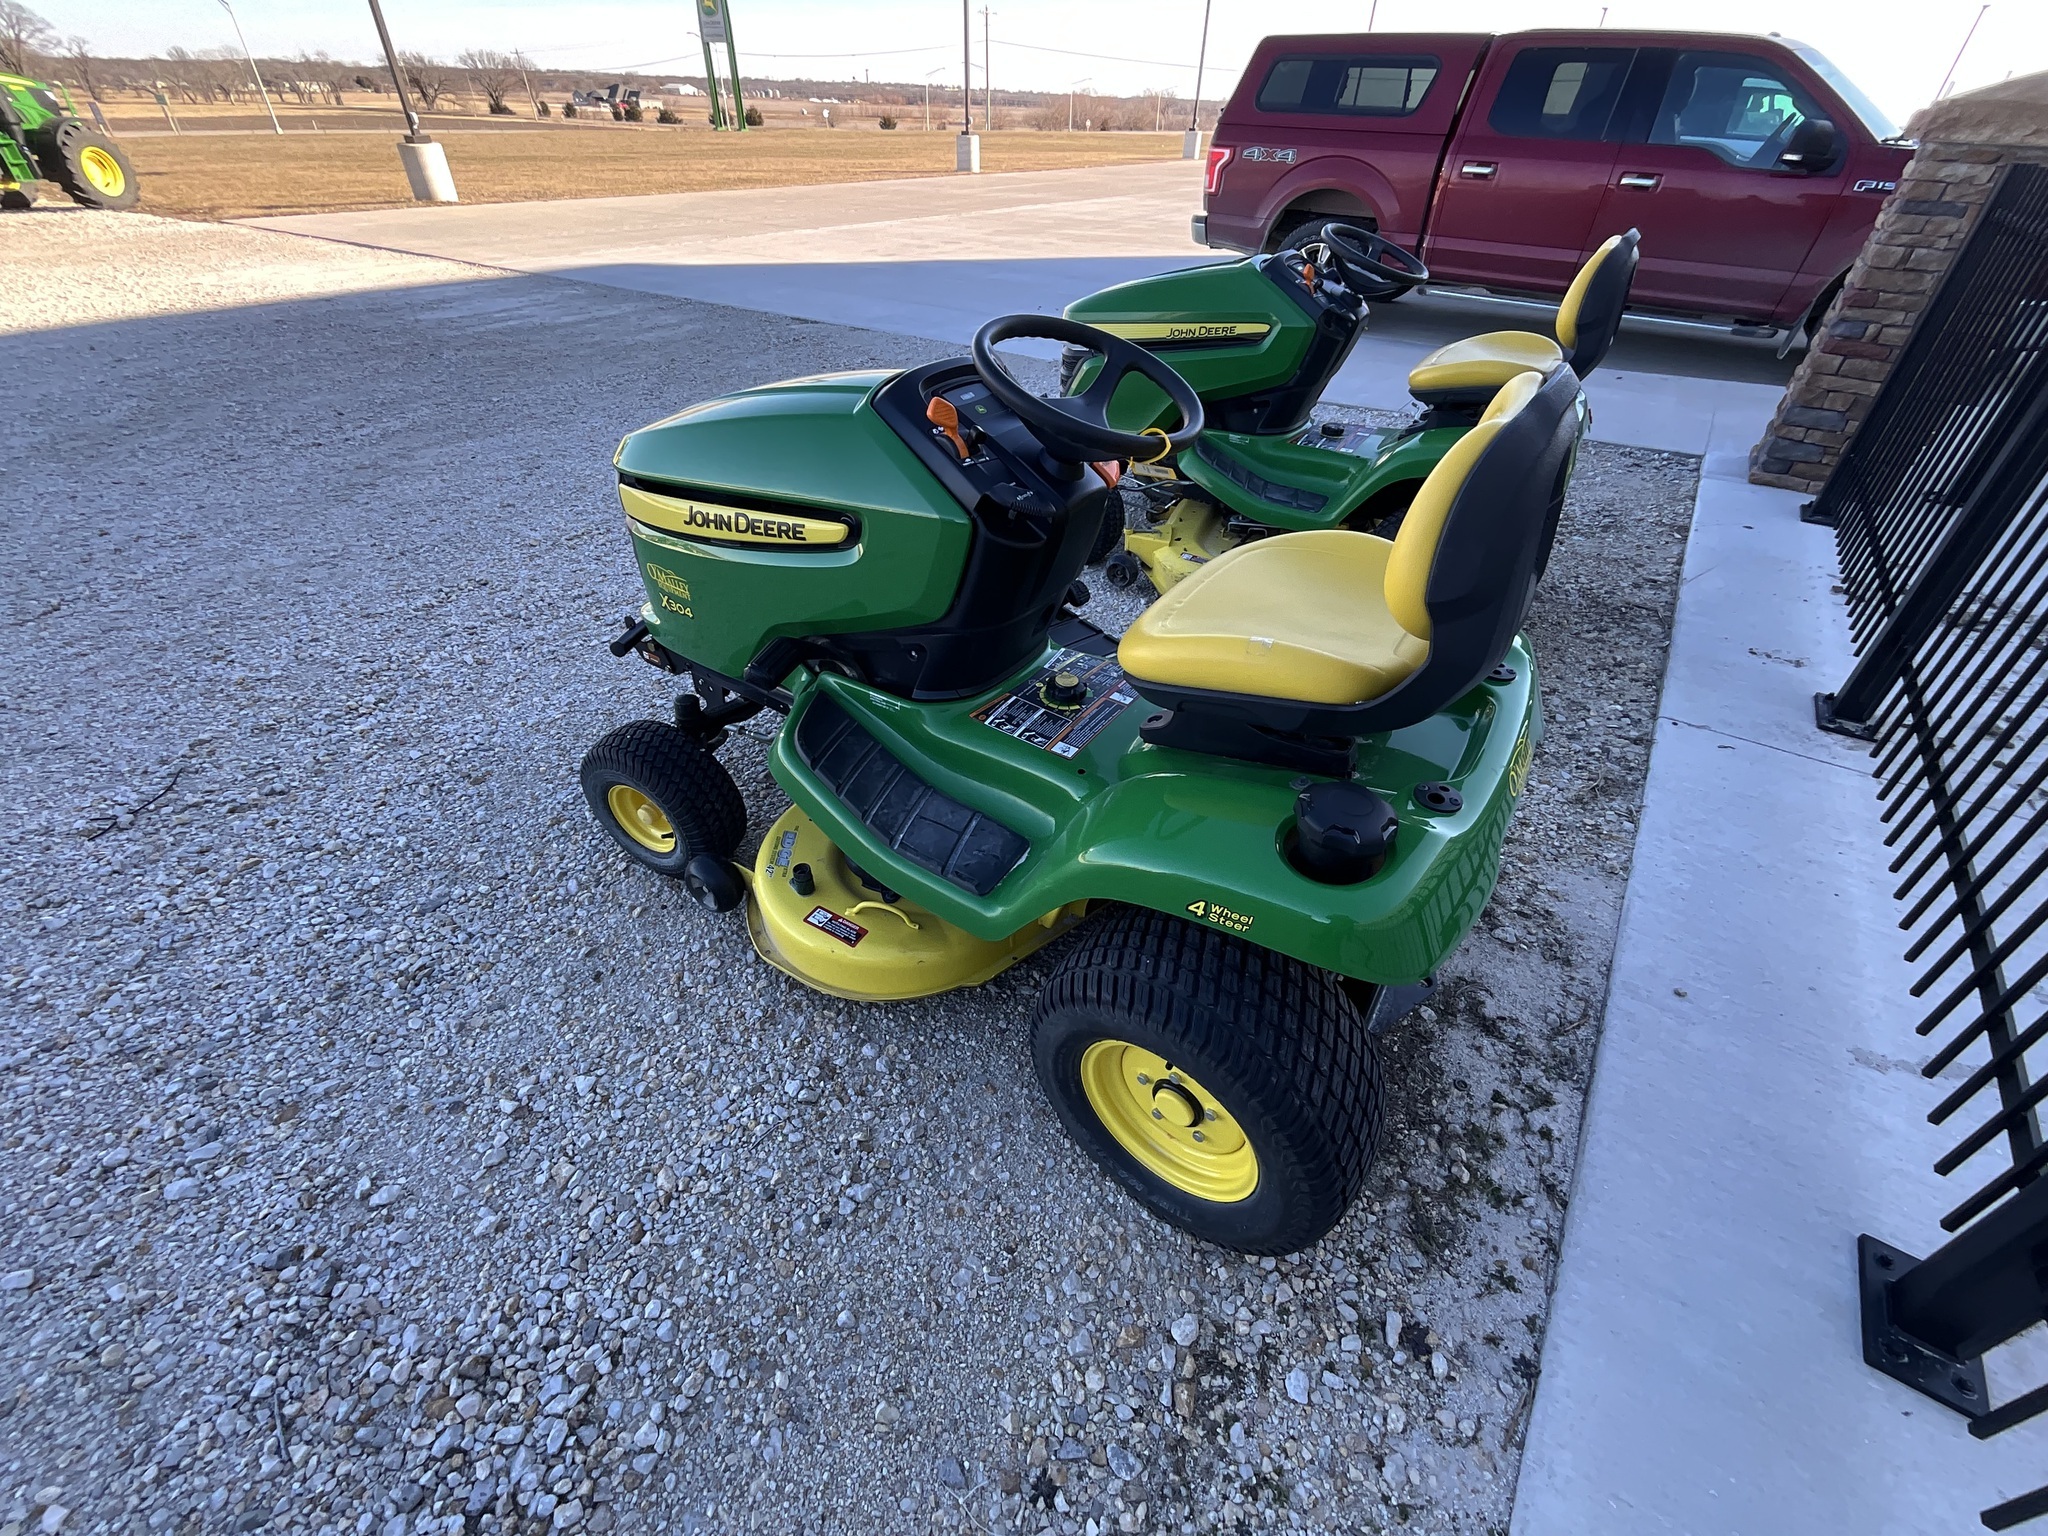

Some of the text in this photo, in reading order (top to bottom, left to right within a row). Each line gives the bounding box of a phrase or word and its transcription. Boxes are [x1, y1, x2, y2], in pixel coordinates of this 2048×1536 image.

[1166, 325, 1237, 339] JOHN DEERE
[683, 505, 807, 541] JOHN DEERE
[659, 592, 694, 618] X304
[775, 830, 798, 867] EDGE
[1187, 901, 1254, 925] 4 Wheel
[1208, 913, 1250, 932] Steer
